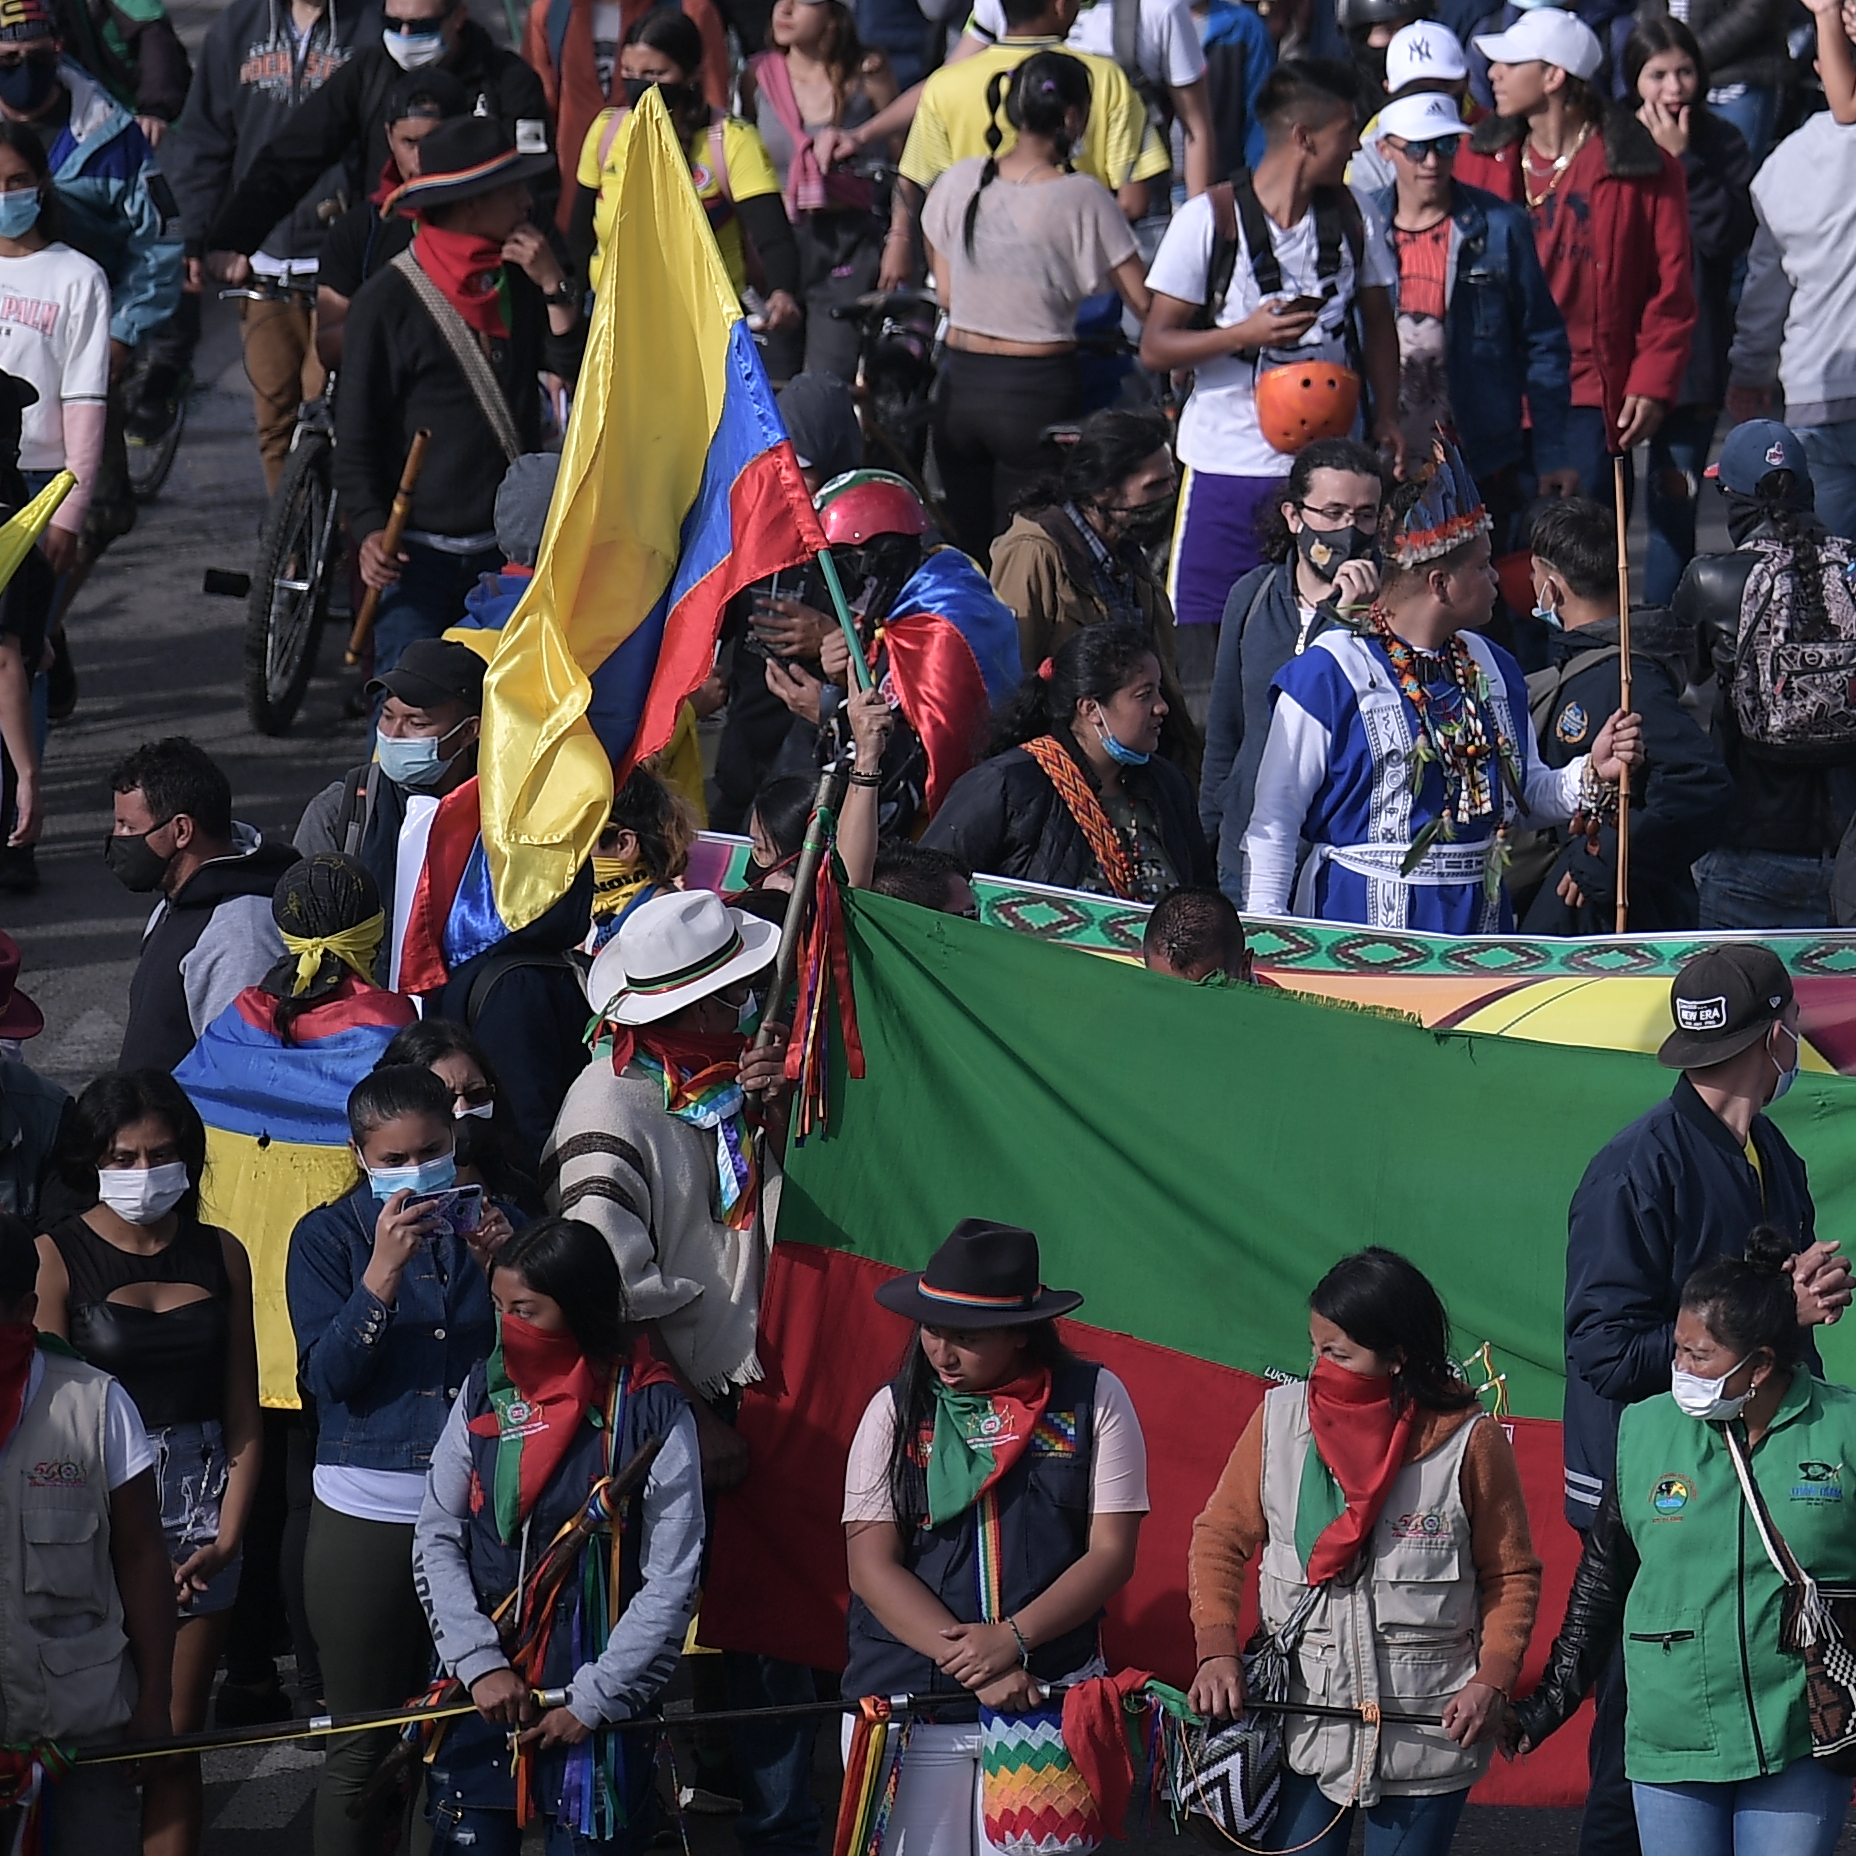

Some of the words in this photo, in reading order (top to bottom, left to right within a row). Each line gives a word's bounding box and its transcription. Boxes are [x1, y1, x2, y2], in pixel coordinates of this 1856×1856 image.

[2, 293, 60, 336] PALM
[1681, 1009, 1697, 1020] NEW
[1699, 1007, 1721, 1020] ERA
